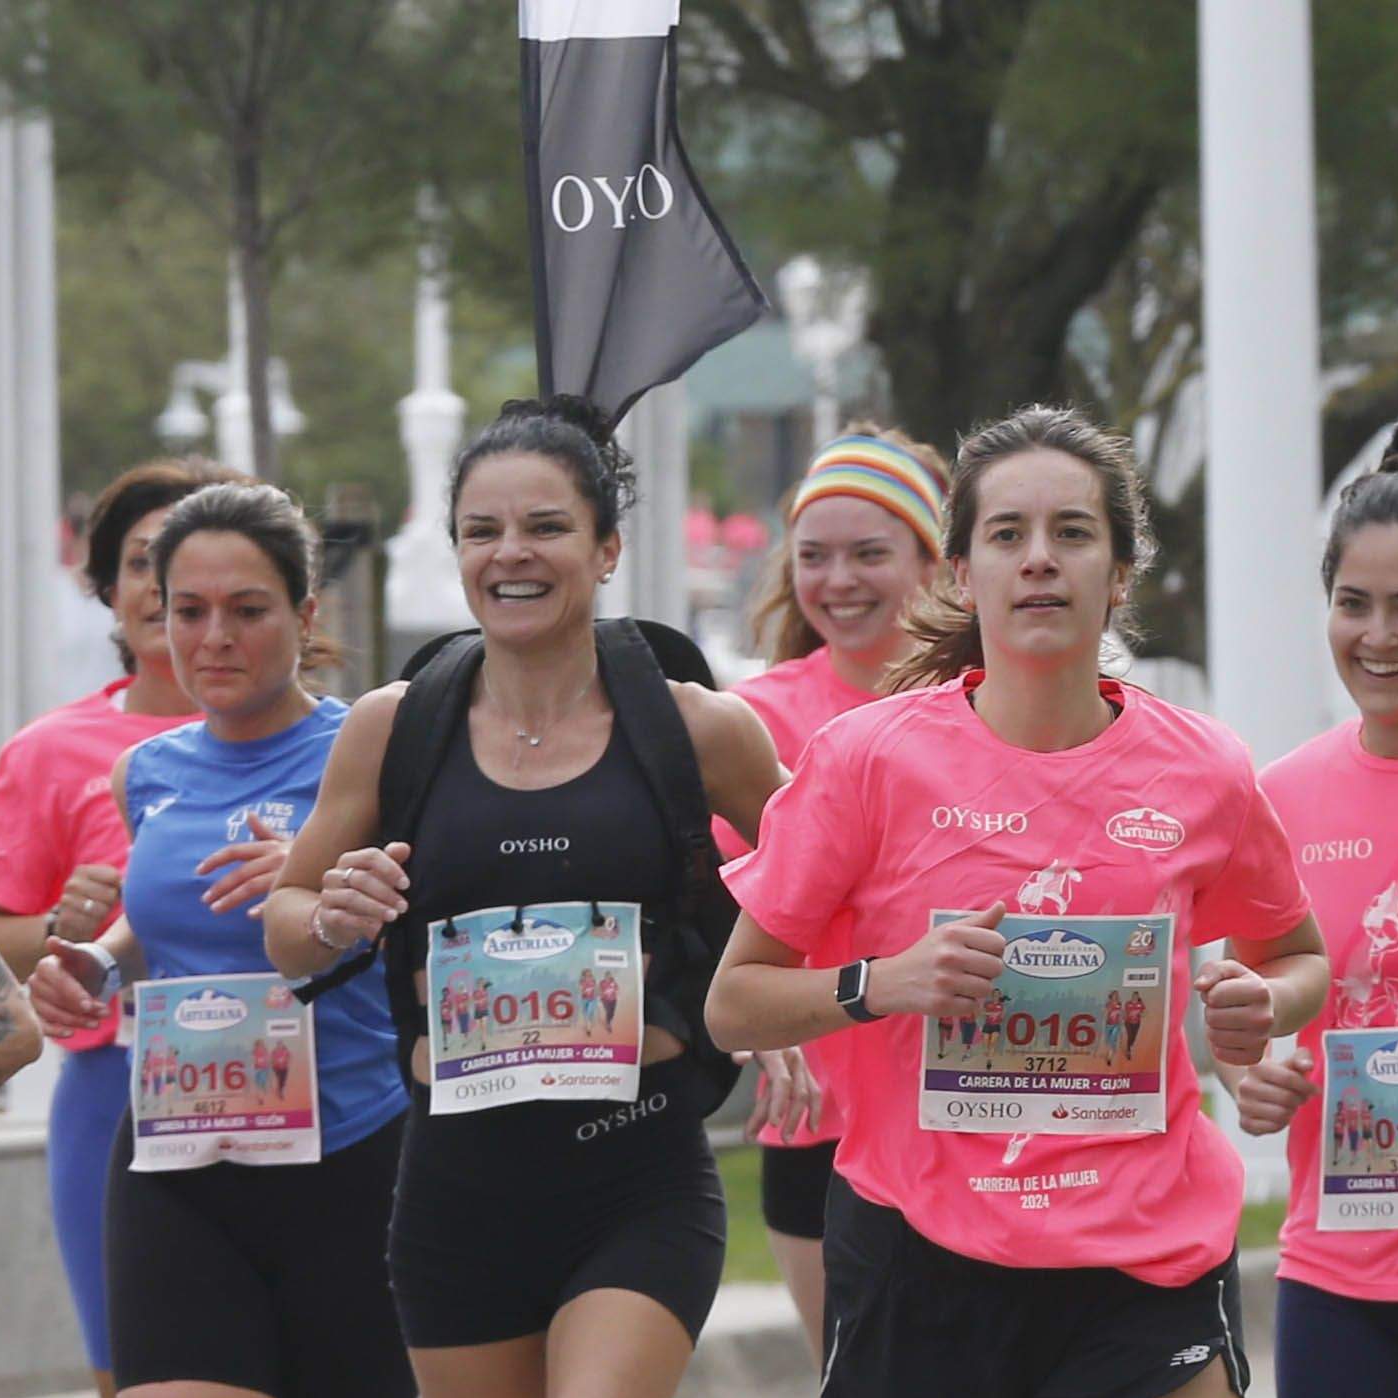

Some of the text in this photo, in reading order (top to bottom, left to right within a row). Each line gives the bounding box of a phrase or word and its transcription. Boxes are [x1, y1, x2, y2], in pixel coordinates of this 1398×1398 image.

[931, 806, 1028, 835] OYSHO
[499, 836, 570, 854] OYSHO
[1302, 837, 1373, 865] OYSHO
[488, 934, 570, 954] ASTURIANA
[1130, 931, 1153, 947] 20
[1007, 945, 1100, 967] ASTURIANA
[492, 989, 575, 1026] 016
[521, 1030, 541, 1045] 22
[1006, 1012, 1097, 1047] 016
[521, 1050, 536, 1061] LA
[537, 1048, 575, 1060] MUJER
[1024, 1056, 1068, 1072] 3712
[179, 1061, 247, 1093] 016
[557, 1074, 622, 1087] Santander
[958, 1075, 1012, 1089] CARRERA
[1014, 1076, 1029, 1089] DE
[1031, 1076, 1048, 1089] LA
[1051, 1077, 1091, 1090] MUJER
[455, 1075, 516, 1100] OYSHO
[576, 1093, 668, 1141] OYSHO
[946, 1100, 1023, 1119] OYSHO
[1071, 1106, 1139, 1120] Santander
[968, 1169, 1099, 1193] CARRERA DE LA MUJER
[1020, 1194, 1050, 1209] 2024
[1338, 1201, 1395, 1217] OYSHO
